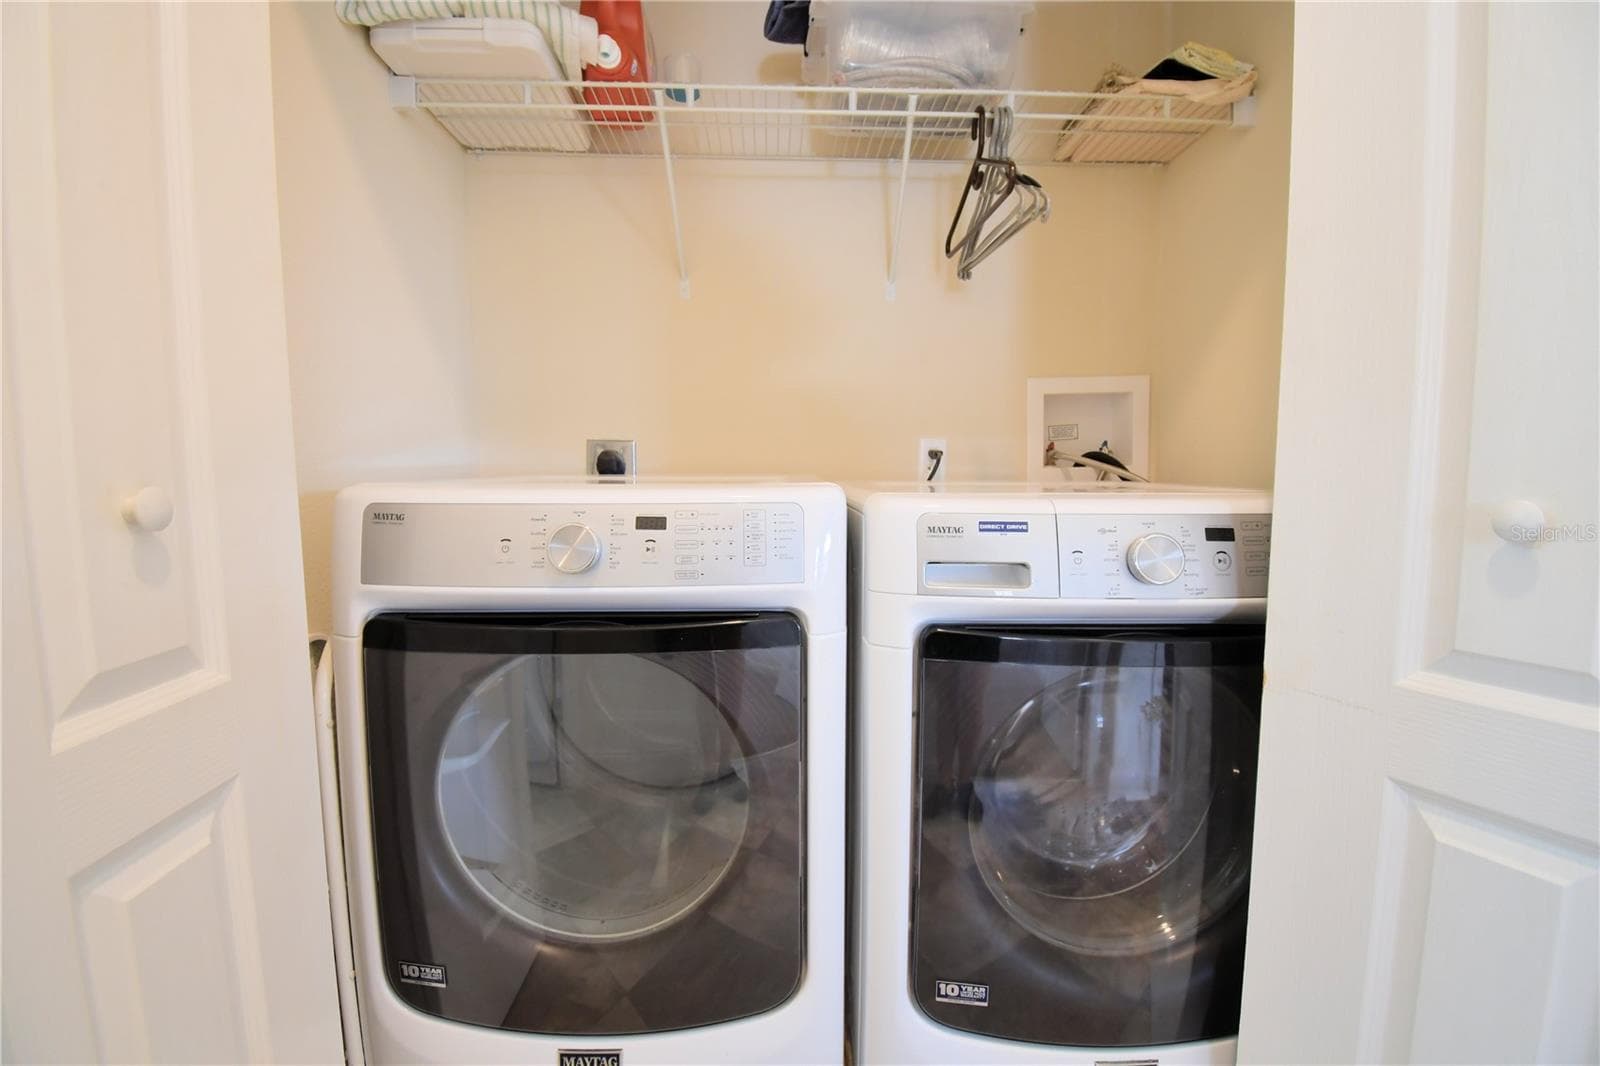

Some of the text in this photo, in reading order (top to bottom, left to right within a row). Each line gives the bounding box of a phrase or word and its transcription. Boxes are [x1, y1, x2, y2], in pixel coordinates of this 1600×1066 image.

[372, 512, 405, 521] MAYTAG
[927, 526, 964, 534] MAYTAG
[401, 964, 420, 978] 10
[421, 967, 442, 975] YEAR
[939, 983, 960, 997] 10
[961, 985, 986, 993] YEAR
[562, 1056, 618, 1066] MAYTAG
